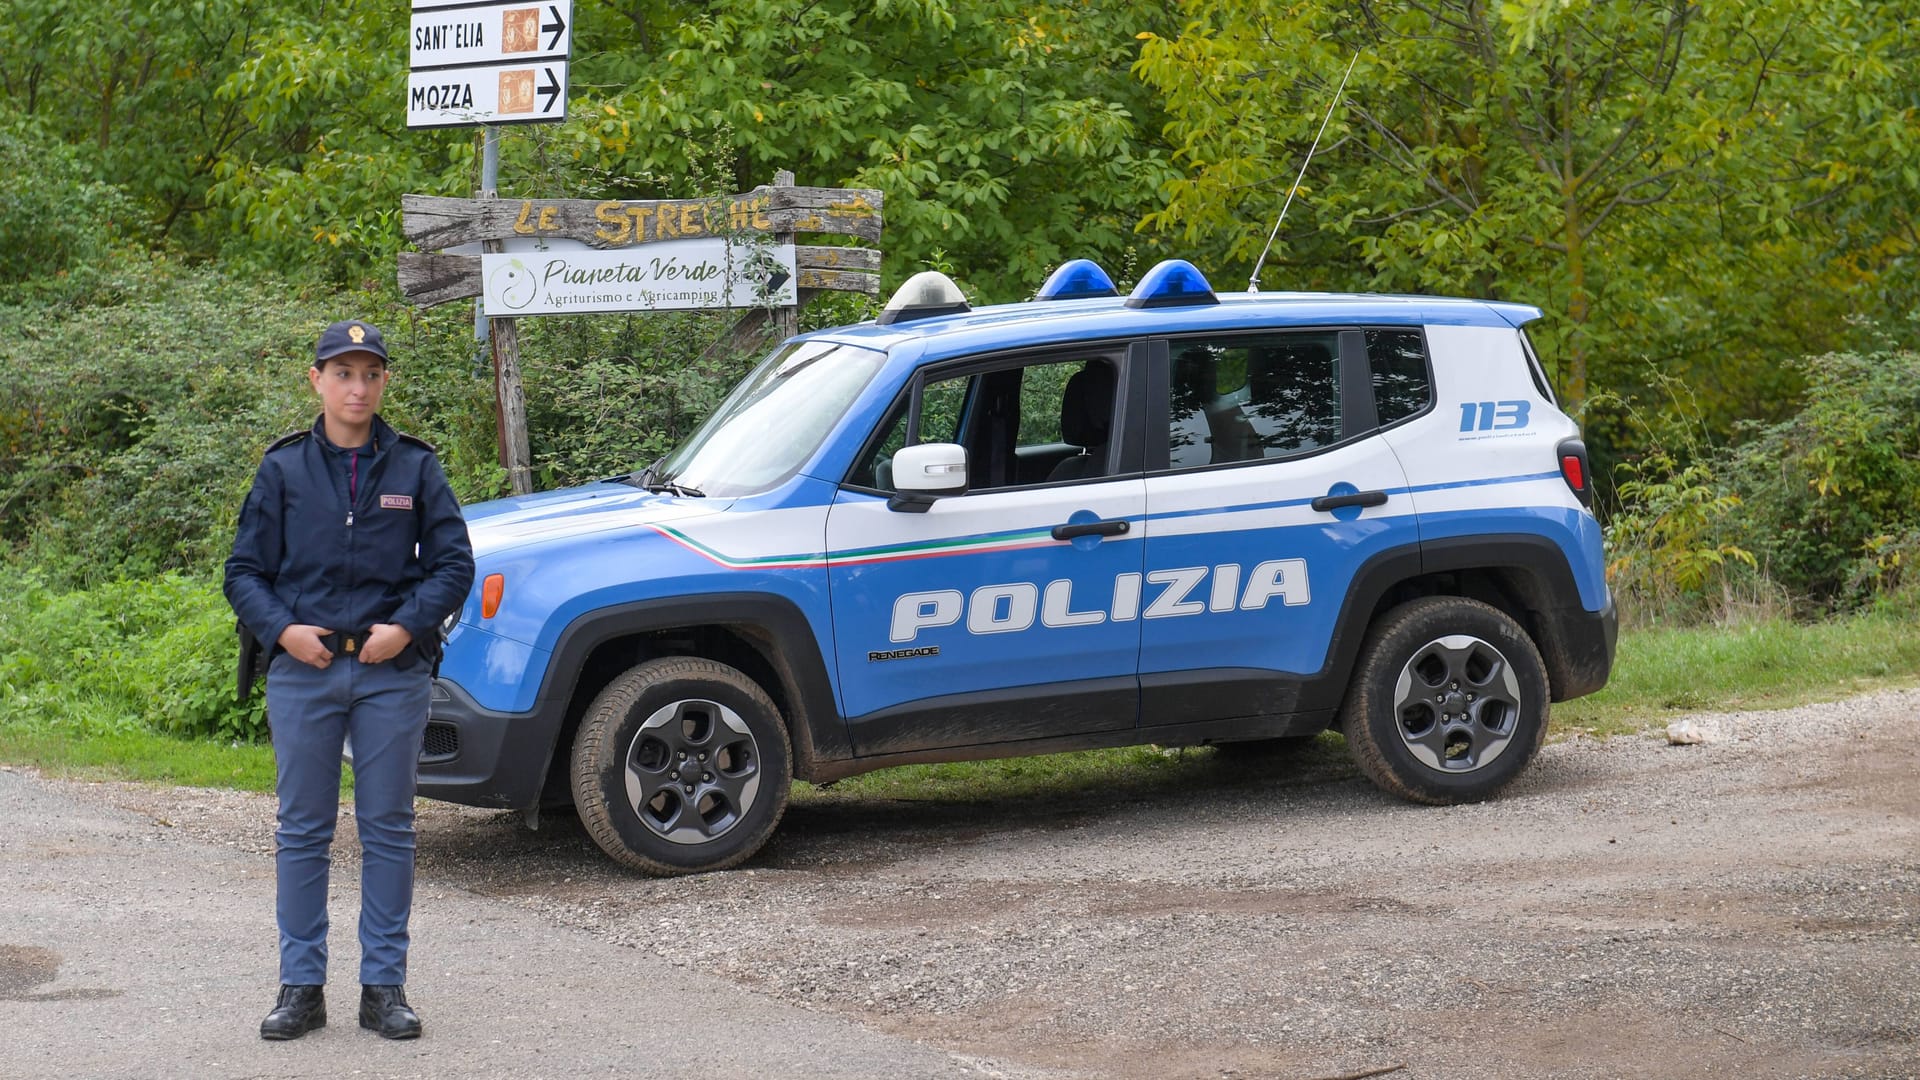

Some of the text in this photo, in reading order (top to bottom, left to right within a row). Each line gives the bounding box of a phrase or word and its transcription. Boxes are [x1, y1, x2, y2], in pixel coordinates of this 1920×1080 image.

[416, 23, 483, 50] SANT'ELIA
[412, 84, 473, 111] MOZZA
[513, 202, 560, 234] LE
[543, 256, 726, 287] Pianeta Verde
[544, 291, 623, 308] Agriturismo
[638, 288, 718, 305] Agricamping
[1460, 400, 1531, 432] 113
[383, 498, 410, 506] POLIZIA
[889, 558, 1311, 643] POLIZIA
[868, 646, 939, 662] RENEGADE
